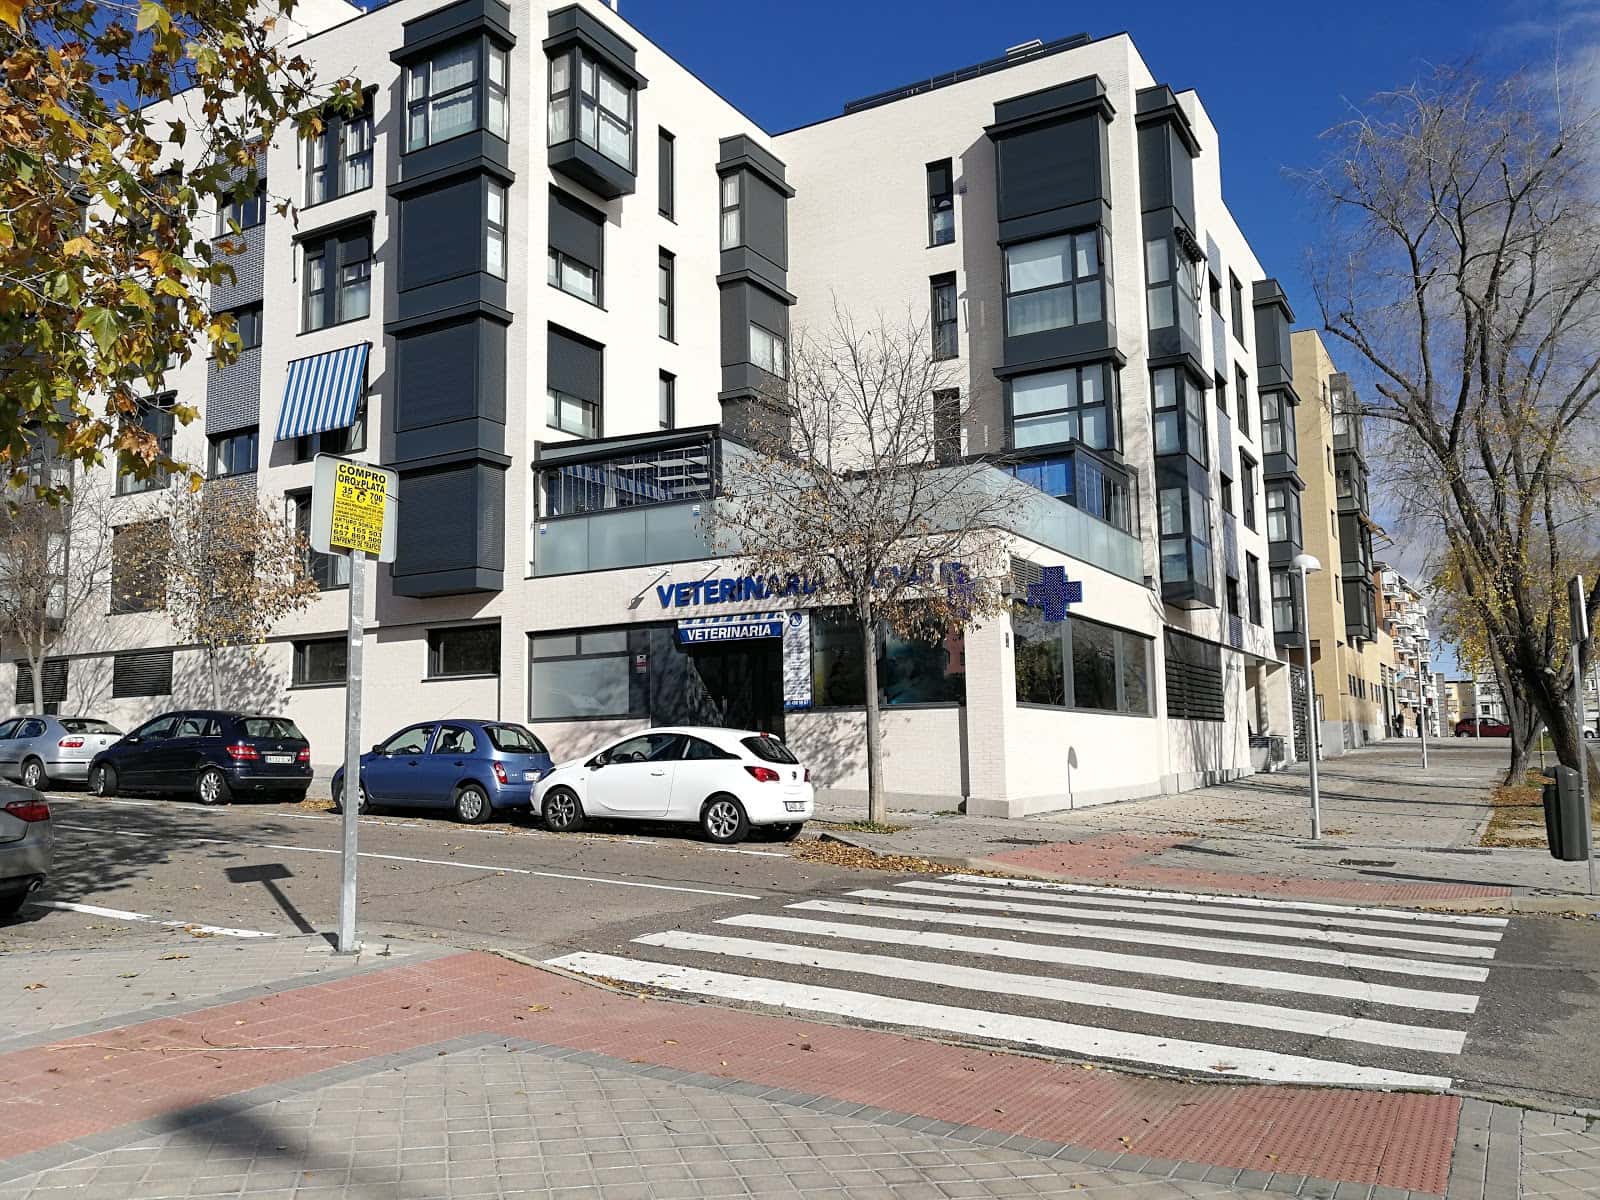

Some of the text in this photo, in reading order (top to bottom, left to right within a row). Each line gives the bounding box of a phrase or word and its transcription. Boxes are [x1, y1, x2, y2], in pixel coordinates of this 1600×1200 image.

[338, 474, 355, 486] ORO
[361, 480, 385, 494] PLATA
[339, 464, 386, 484] COMPRO
[687, 624, 771, 640] VETERINARIA
